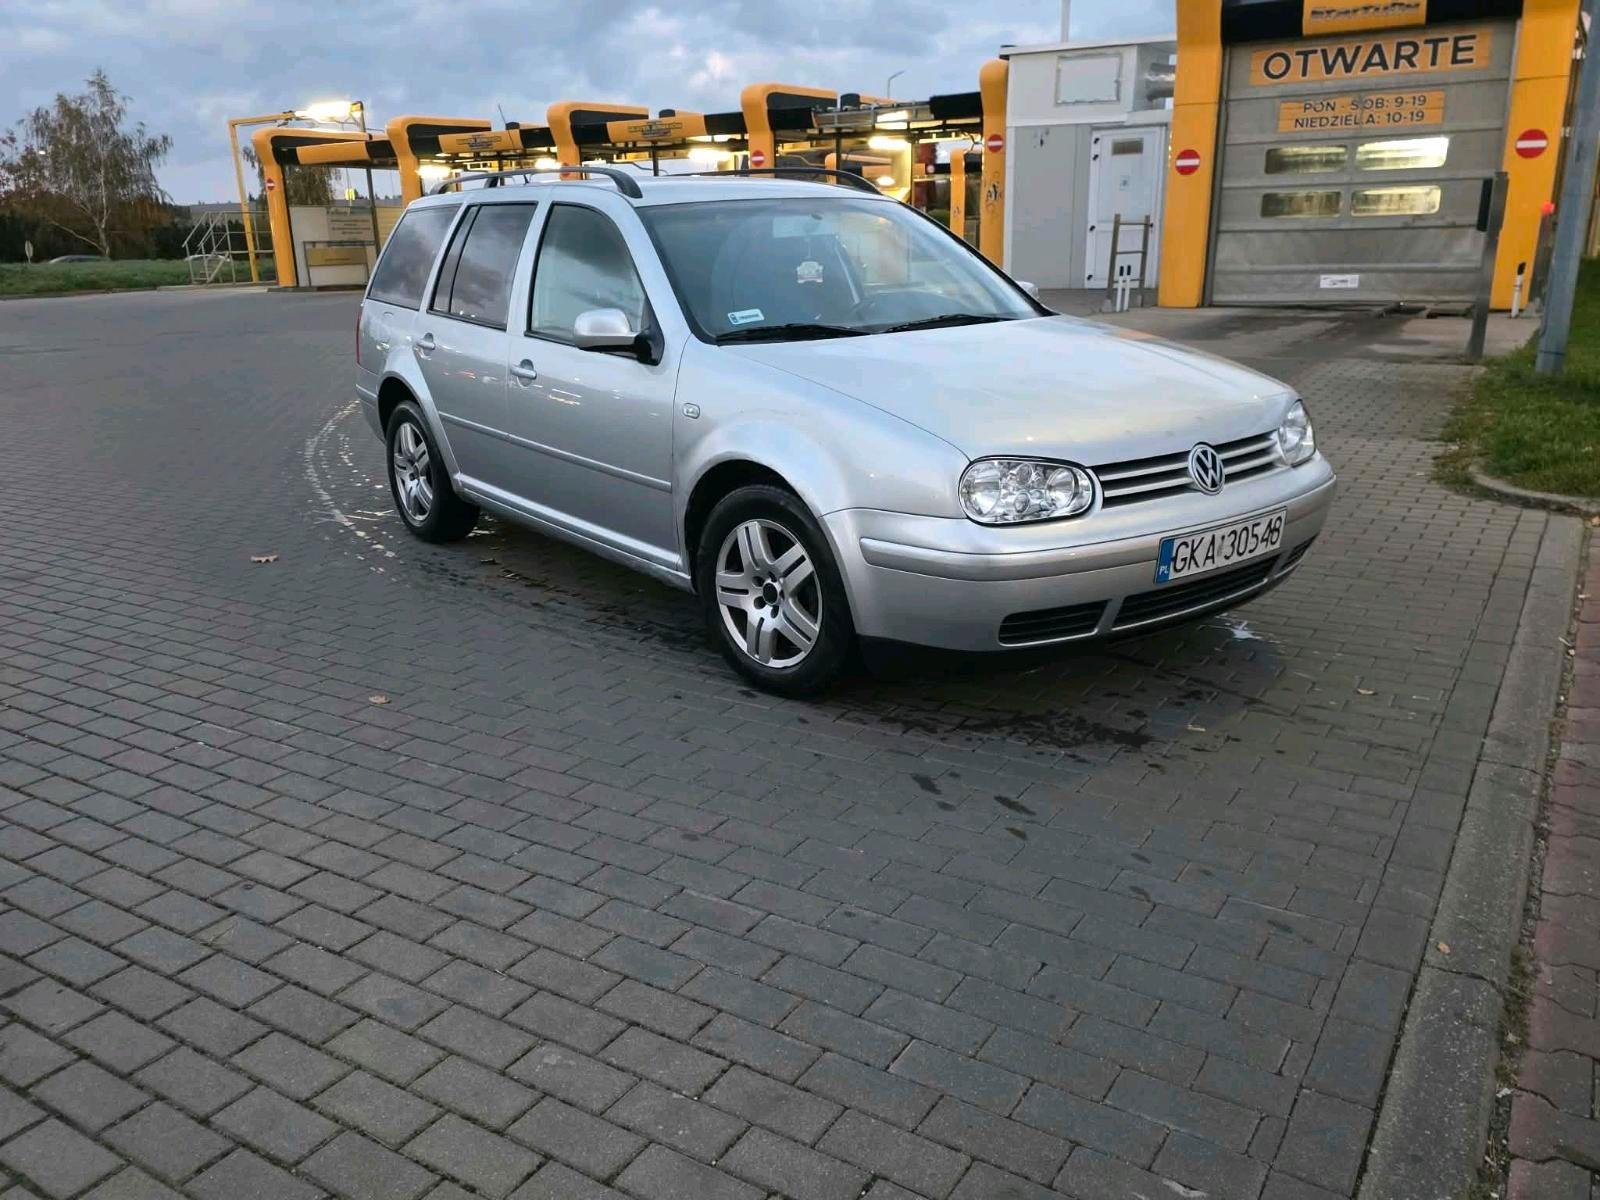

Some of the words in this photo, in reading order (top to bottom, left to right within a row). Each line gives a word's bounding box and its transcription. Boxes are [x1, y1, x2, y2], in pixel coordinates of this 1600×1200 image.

[1263, 34, 1477, 80] OTWARTE
[1303, 101, 1336, 113] PON
[1394, 95, 1427, 108] 9-19
[1294, 113, 1380, 129] NIEDZIELA:
[1386, 110, 1425, 124] 10-19
[1172, 533, 1216, 573] GKA
[1223, 516, 1283, 560] 30548
[1159, 565, 1169, 575] PL
